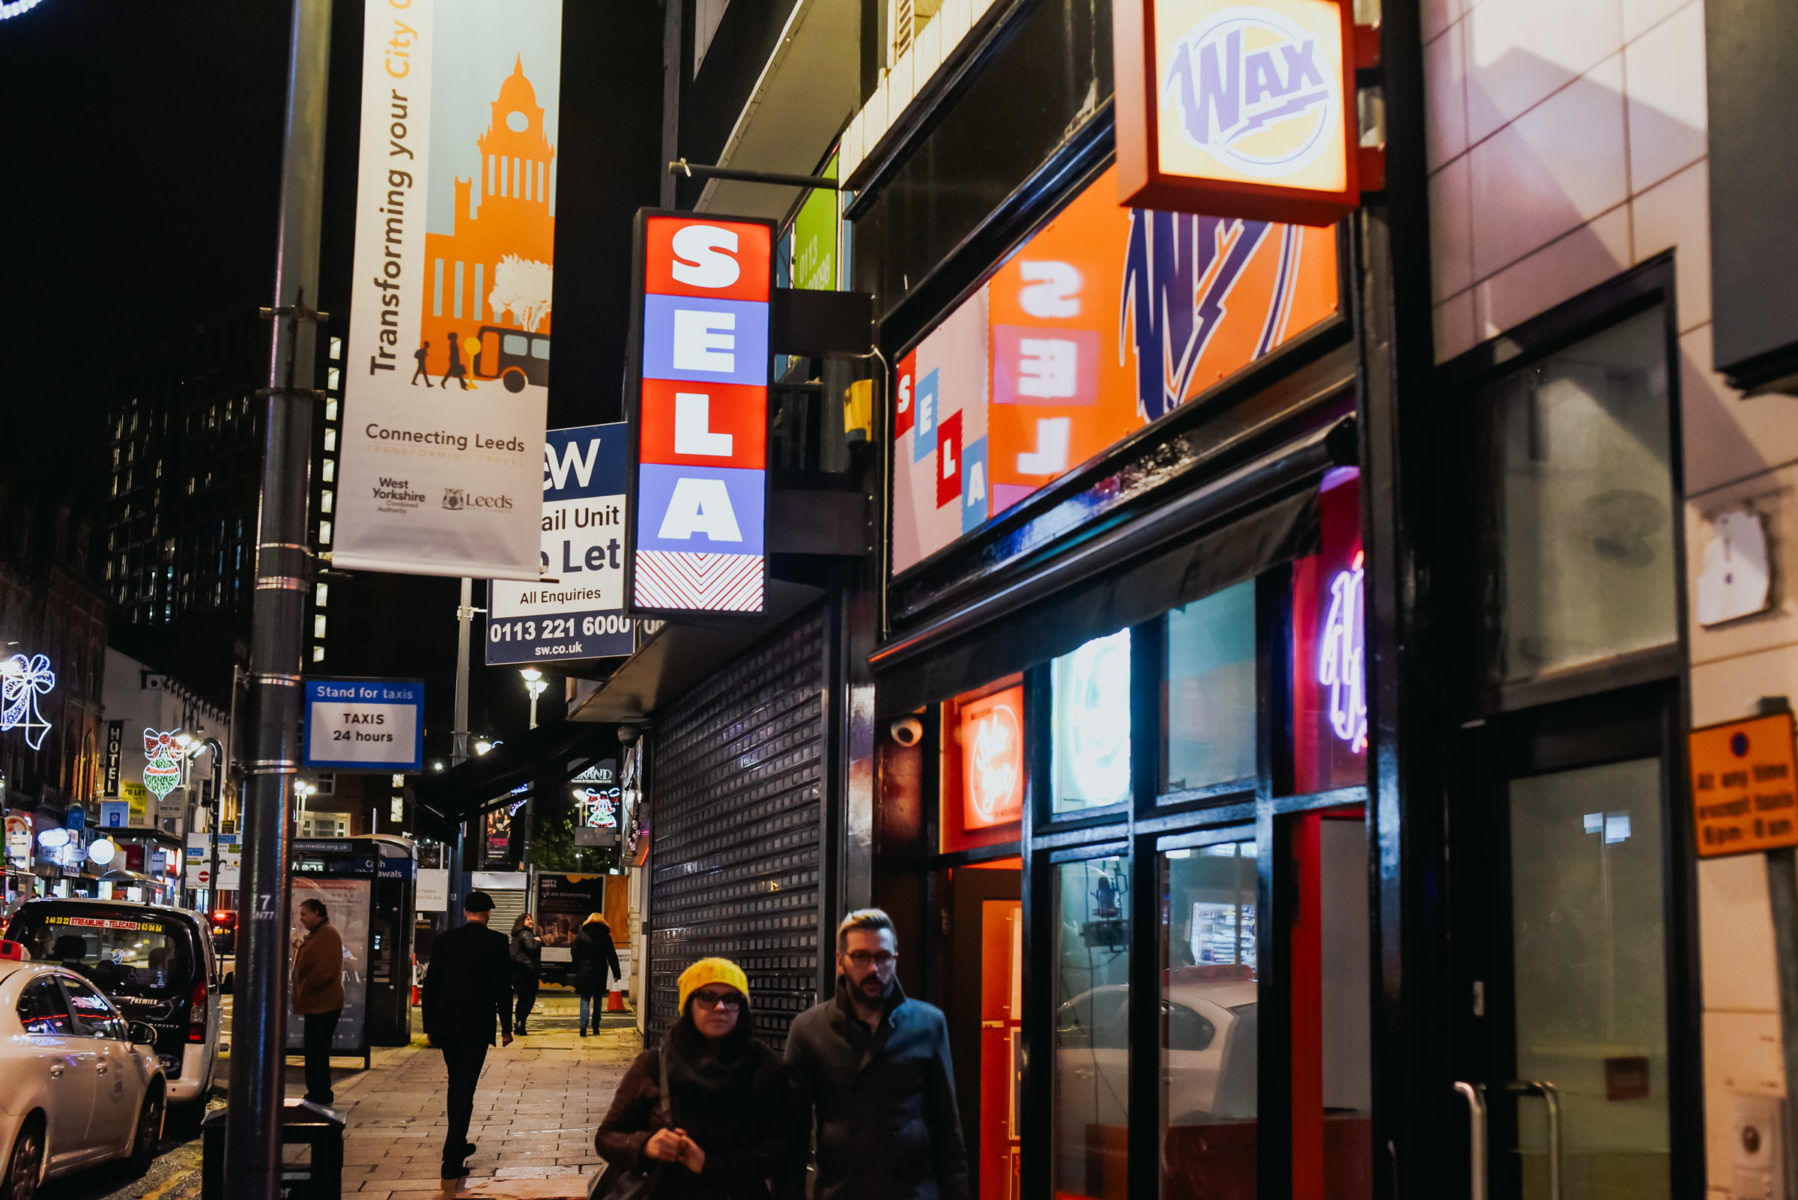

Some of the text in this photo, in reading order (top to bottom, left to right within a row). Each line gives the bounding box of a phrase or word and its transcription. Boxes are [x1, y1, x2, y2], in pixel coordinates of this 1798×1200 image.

[385, 20, 418, 79] City
[1167, 28, 1325, 145] WAX
[390, 89, 413, 159] your
[370, 169, 413, 375] Transforming
[658, 225, 743, 542] SELA
[366, 423, 525, 453] Connecting Leeds
[898, 374, 985, 507] SELA
[379, 477, 409, 490] West
[372, 488, 426, 503] Yorkshire
[466, 493, 513, 509] Leeds
[575, 505, 620, 530] Unit
[563, 538, 620, 574] Let
[520, 588, 601, 605] All Enquiries
[490, 620, 536, 642] 0113
[541, 617, 575, 639] 221
[582, 614, 631, 636] 6000
[535, 642, 582, 656] sw.co.uk
[317, 686, 413, 699] Stand for taxis
[343, 713, 385, 725] TAXIS
[333, 730, 393, 742] 24 hours
[108, 728, 119, 793] HOTEL
[575, 766, 613, 780] RAND
[365, 860, 386, 868] Cah
[260, 894, 271, 910] 7
